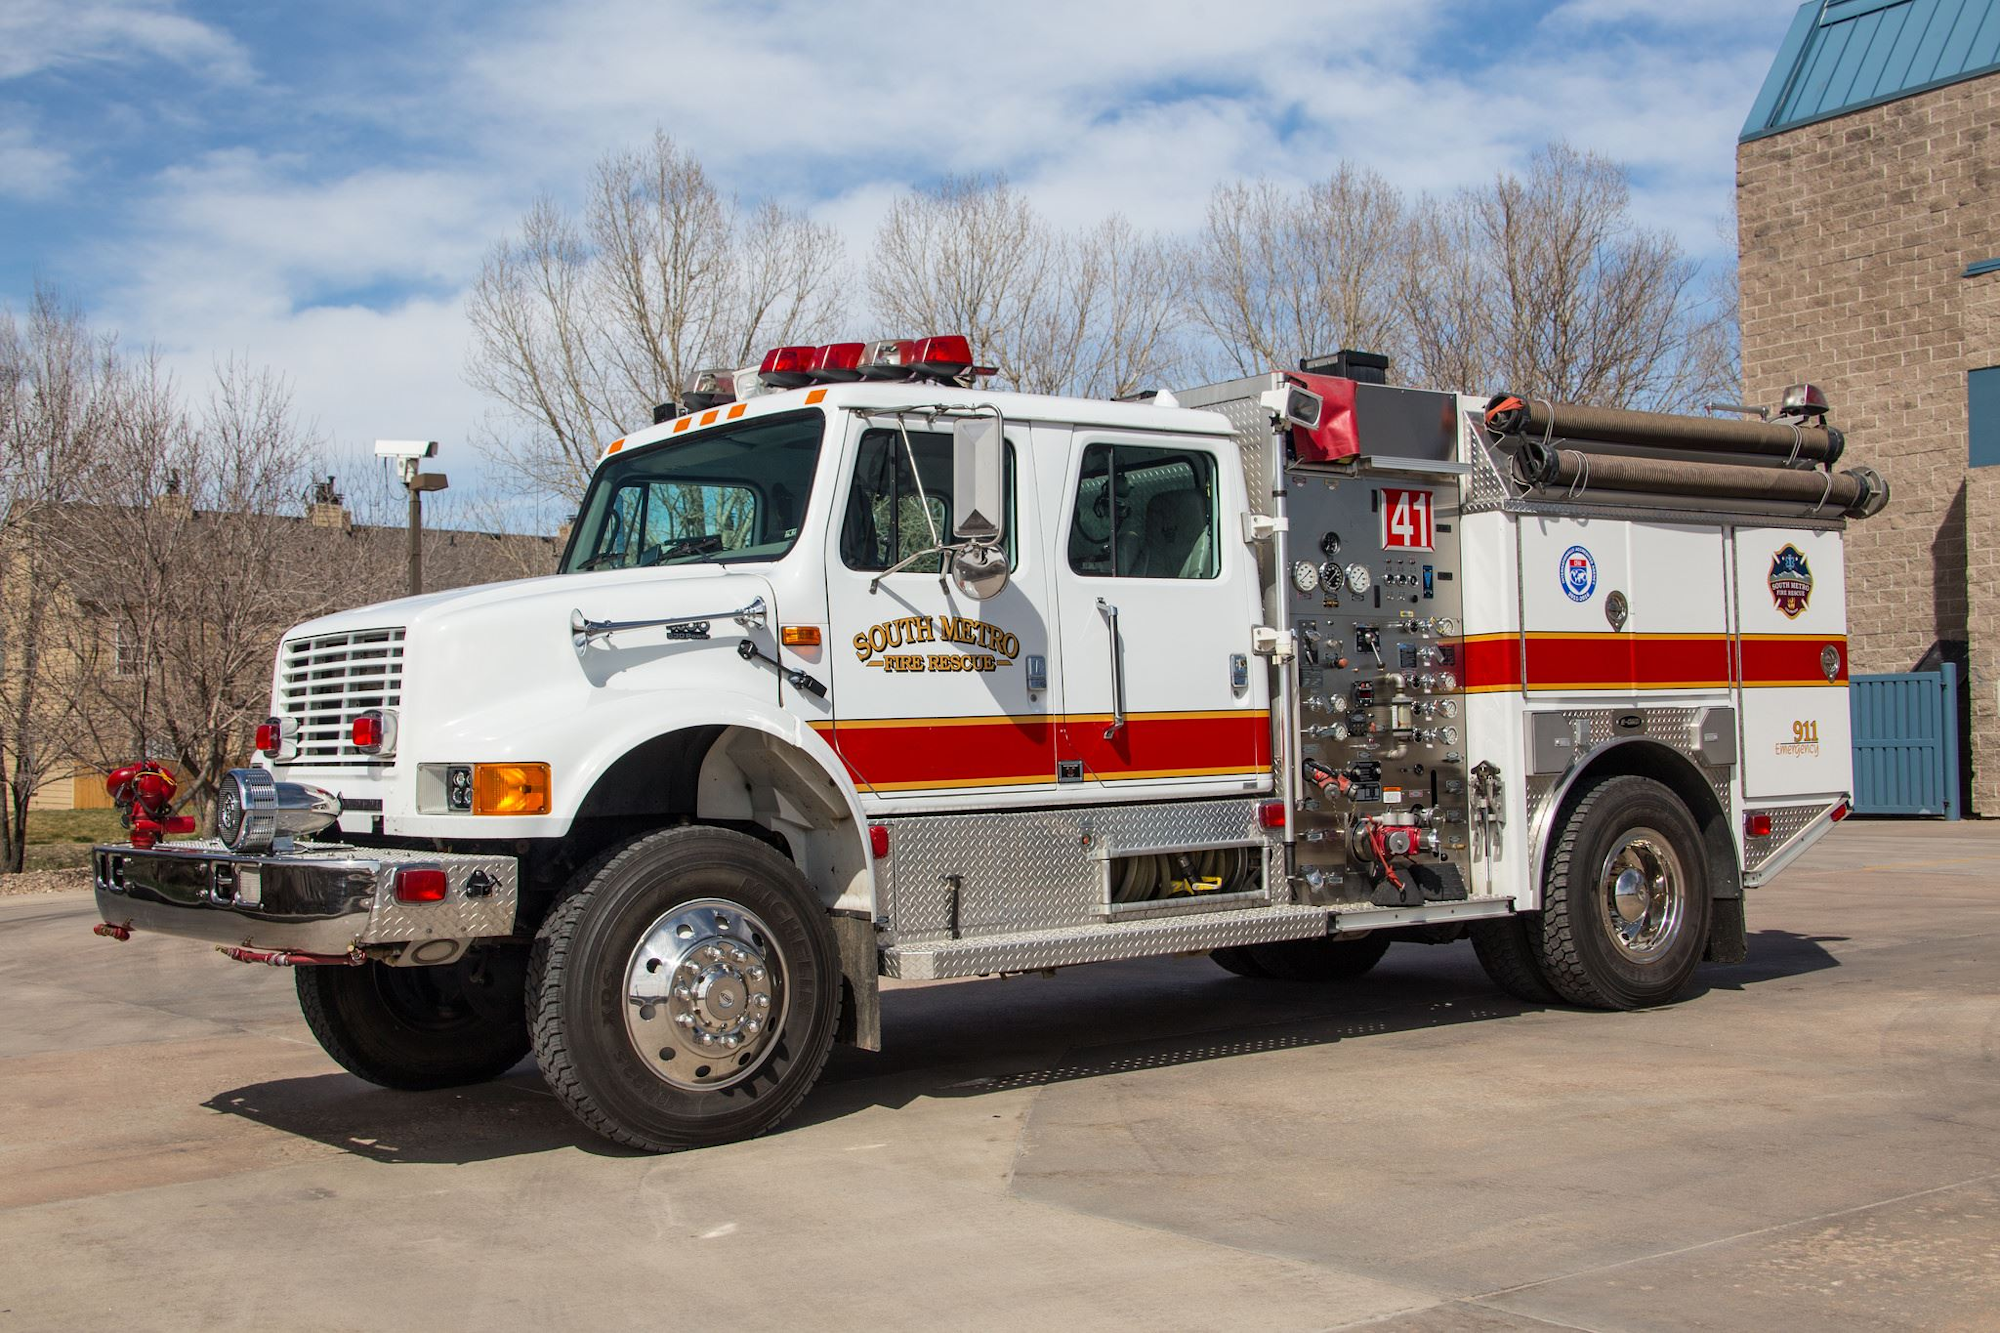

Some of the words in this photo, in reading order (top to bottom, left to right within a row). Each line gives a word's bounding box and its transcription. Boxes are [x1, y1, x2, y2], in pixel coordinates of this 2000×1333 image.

[1391, 491, 1428, 547] 41
[1772, 581, 1791, 591] SOUTH
[1790, 582, 1810, 592] METRO
[853, 615, 936, 662] SOUTH
[939, 615, 1020, 660] METRO
[883, 654, 926, 673] FIRE
[927, 654, 997, 673] RESCUE
[1792, 720, 1819, 743] 911
[1775, 742, 1819, 758] Emergency
[738, 876, 815, 1016] MICHELIN
